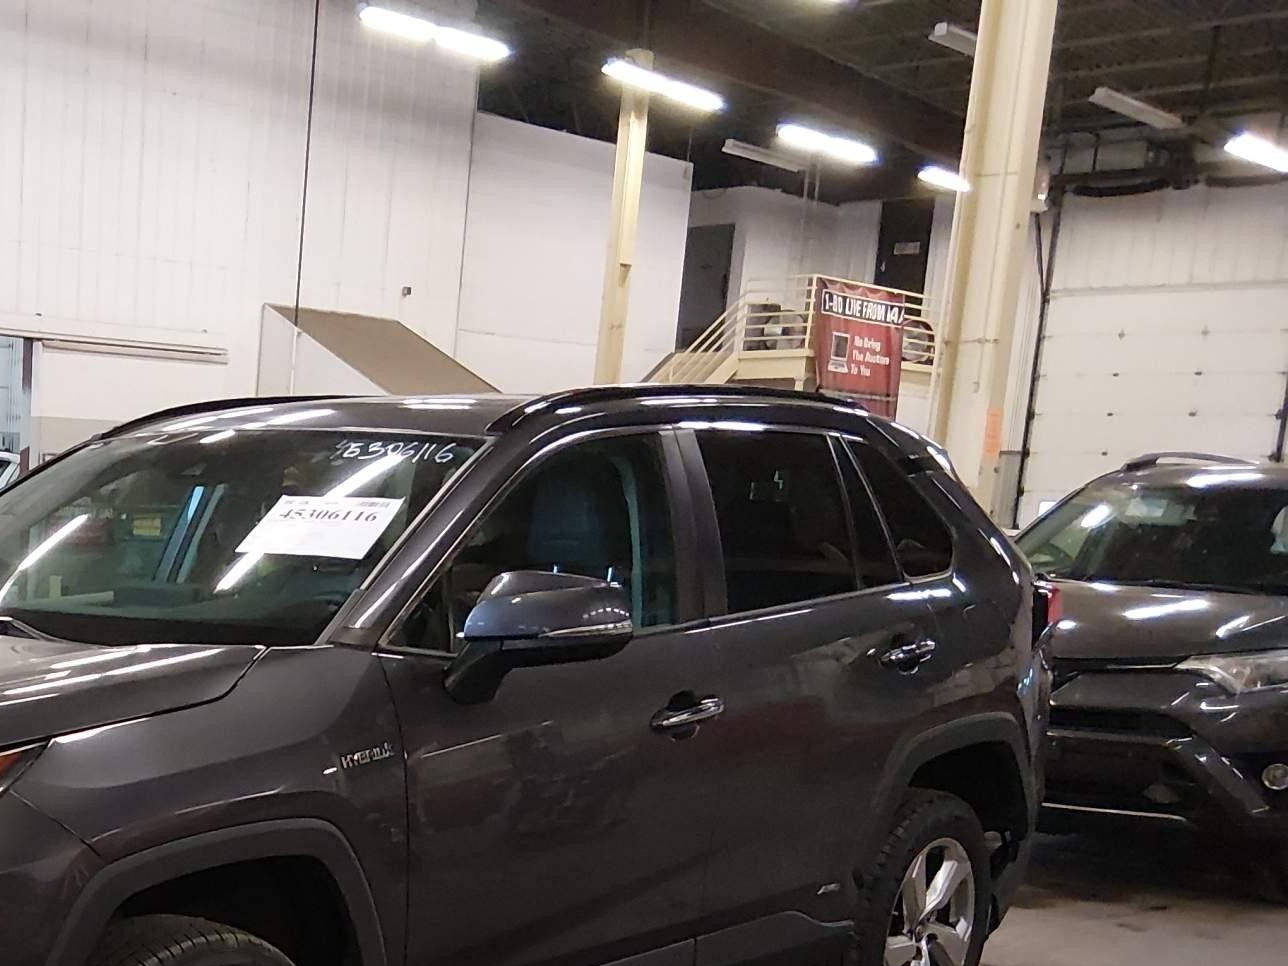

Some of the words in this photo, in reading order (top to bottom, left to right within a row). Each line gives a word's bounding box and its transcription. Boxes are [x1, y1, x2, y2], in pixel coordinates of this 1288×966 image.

[862, 302, 886, 320] FROM
[851, 364, 858, 375] To
[279, 507, 380, 523] 45306116
